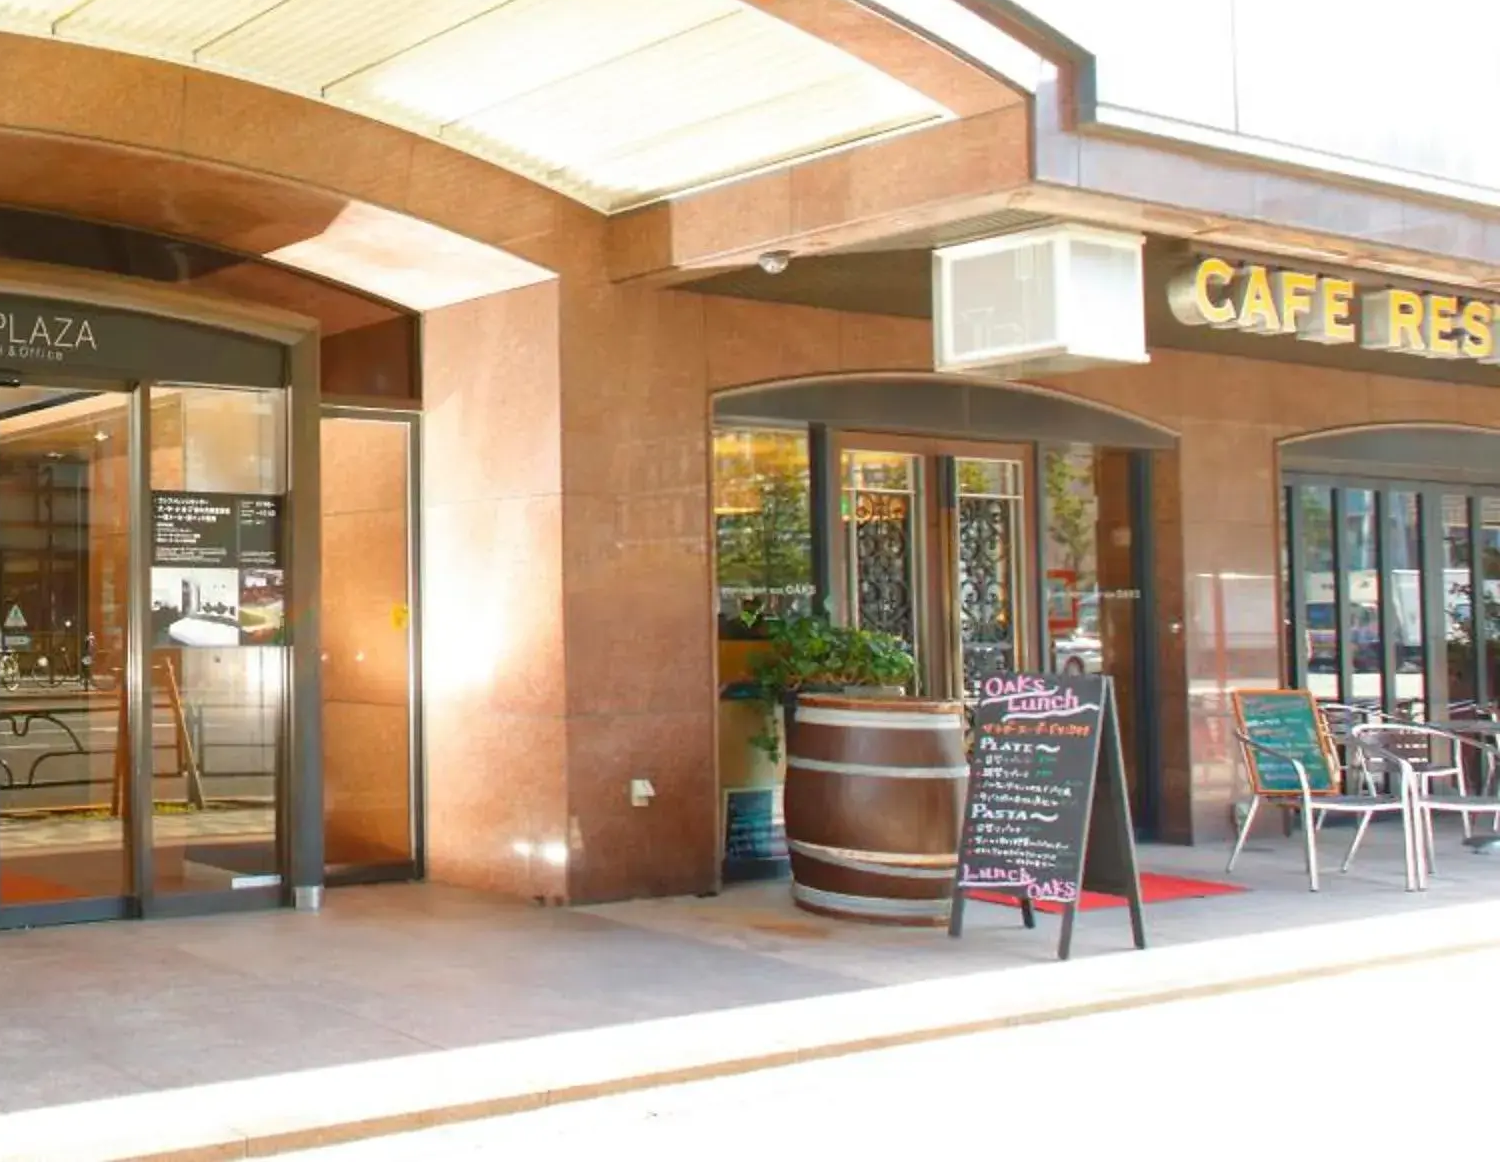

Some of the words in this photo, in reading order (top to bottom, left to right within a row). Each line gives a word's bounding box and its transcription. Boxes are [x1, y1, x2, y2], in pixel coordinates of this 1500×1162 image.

[1192, 257, 1356, 345] CAFE
[1387, 288, 1500, 364] RES
[1007, 688, 1080, 712] Lunch
